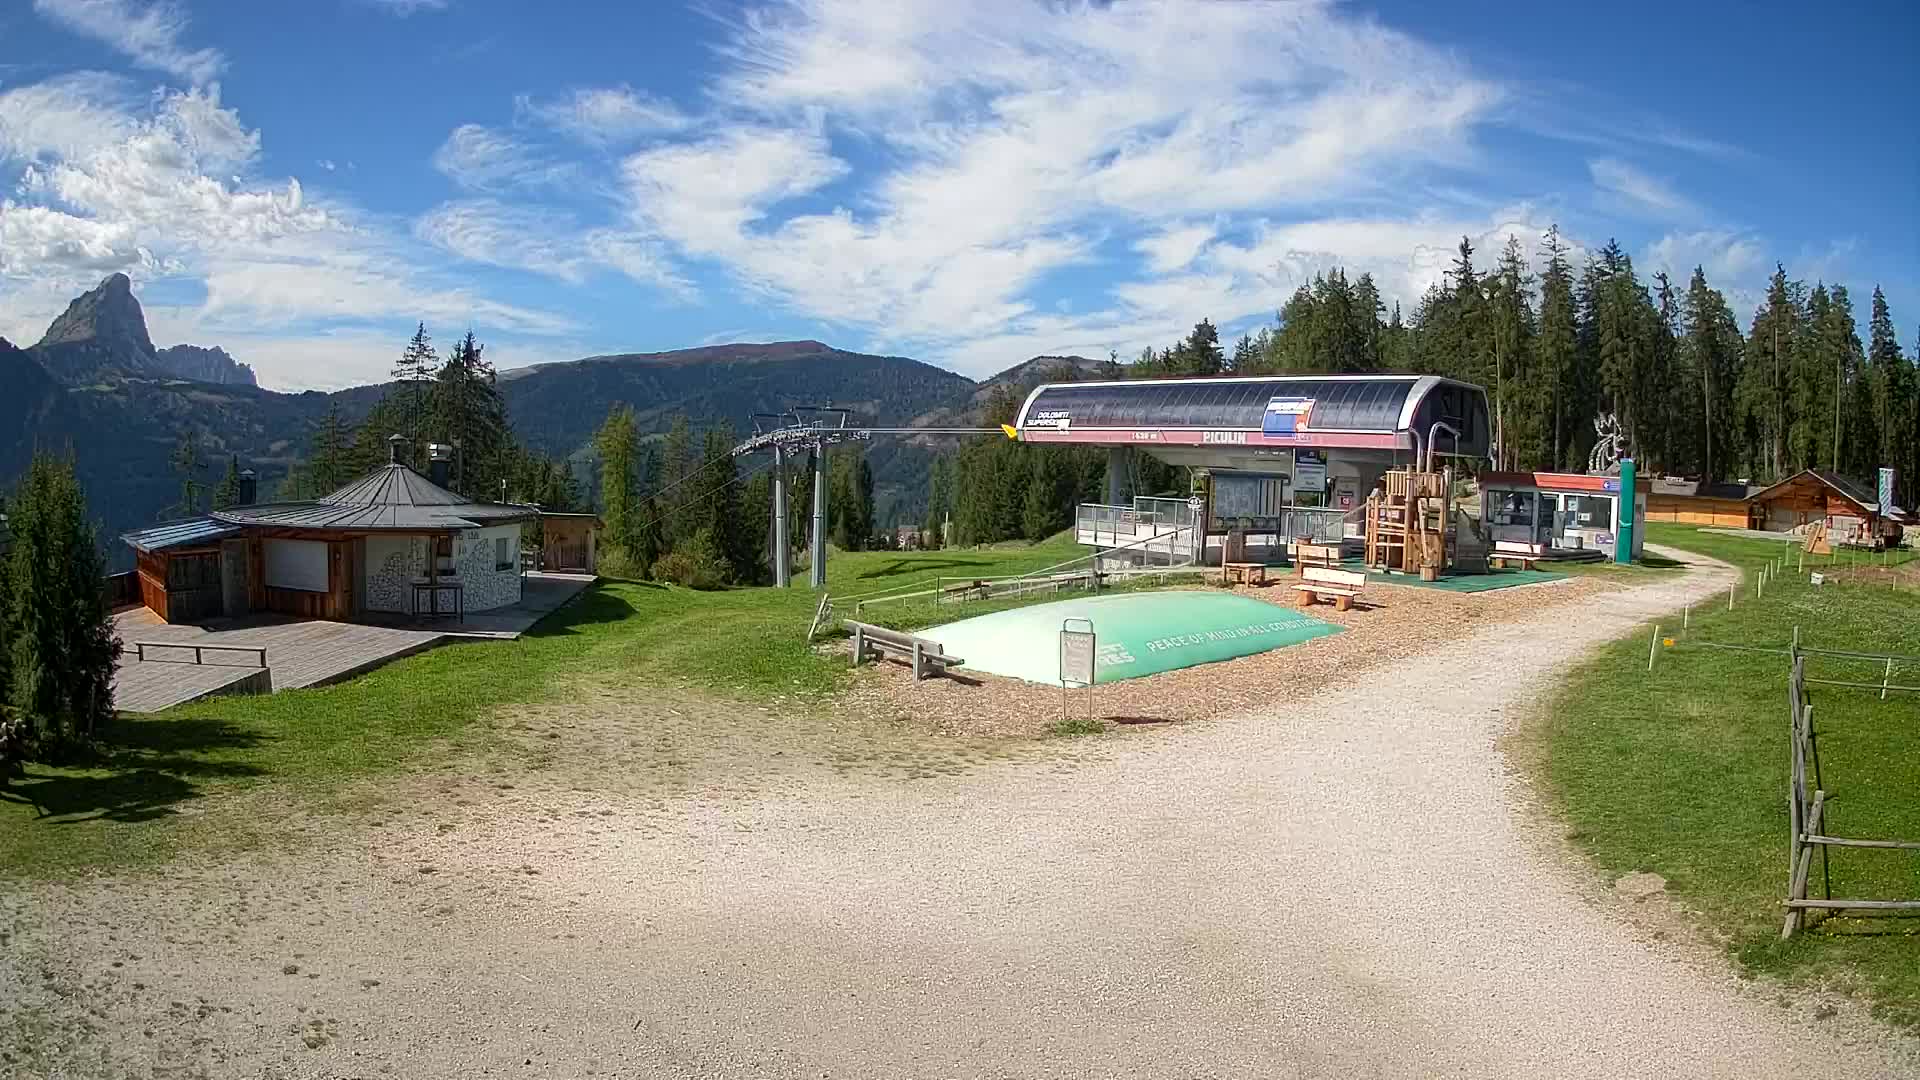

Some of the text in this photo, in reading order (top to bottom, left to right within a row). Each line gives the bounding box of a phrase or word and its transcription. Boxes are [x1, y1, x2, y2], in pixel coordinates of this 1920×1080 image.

[1038, 411, 1069, 419] DOLOMITI
[1203, 431, 1246, 444] PICULIN
[1146, 637, 1189, 653] PEACE
[1189, 632, 1206, 644] OF
[1206, 629, 1236, 641] MIND
